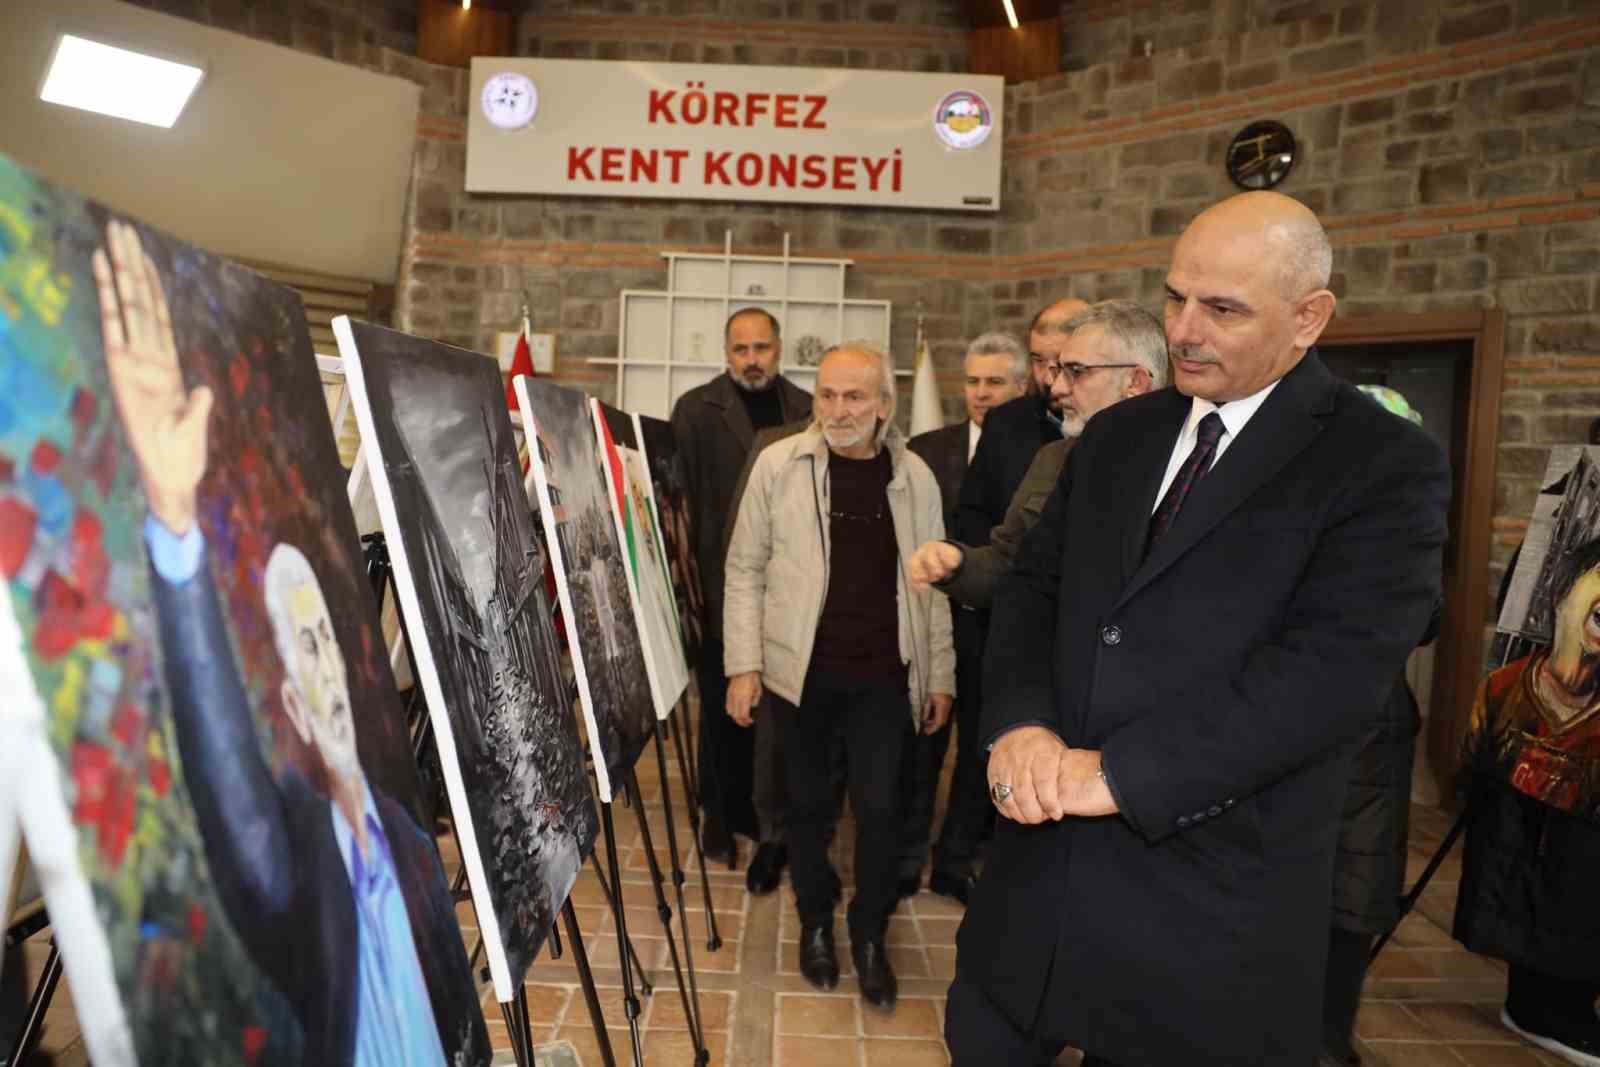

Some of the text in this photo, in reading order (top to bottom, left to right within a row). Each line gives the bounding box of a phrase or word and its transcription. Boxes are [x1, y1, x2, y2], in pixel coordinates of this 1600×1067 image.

[647, 80, 828, 130] KÖRFEZ
[567, 146, 904, 193] KENT KONSEYİ
